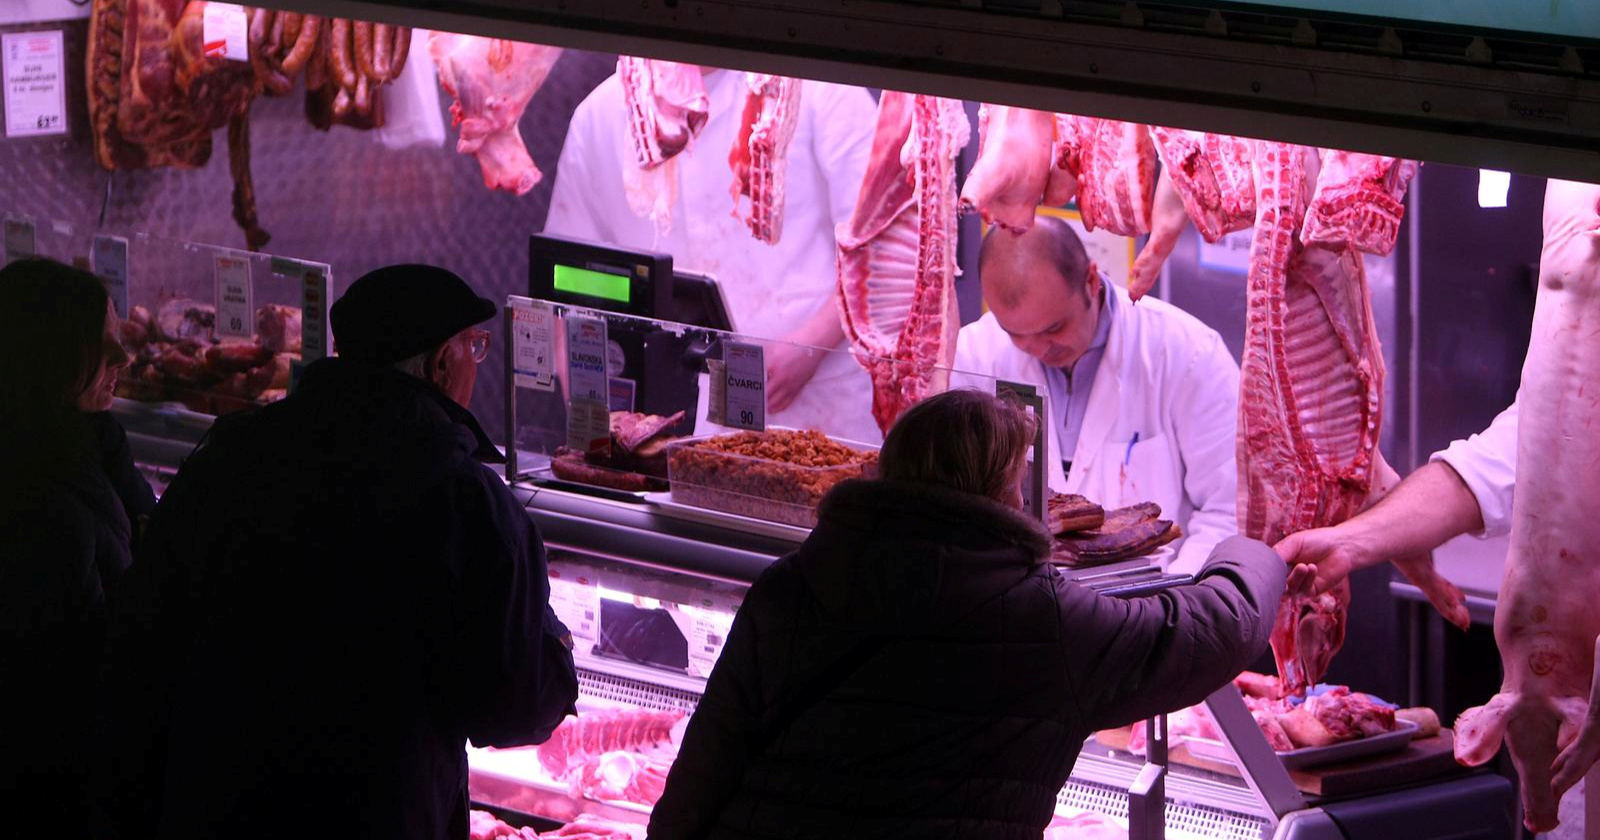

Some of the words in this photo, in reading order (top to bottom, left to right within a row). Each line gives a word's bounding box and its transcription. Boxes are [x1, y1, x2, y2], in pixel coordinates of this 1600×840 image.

[230, 317, 242, 331] 69
[571, 351, 602, 365] SLAVONSKA
[728, 376, 762, 391] ČVARCI
[740, 411, 753, 425] 90
